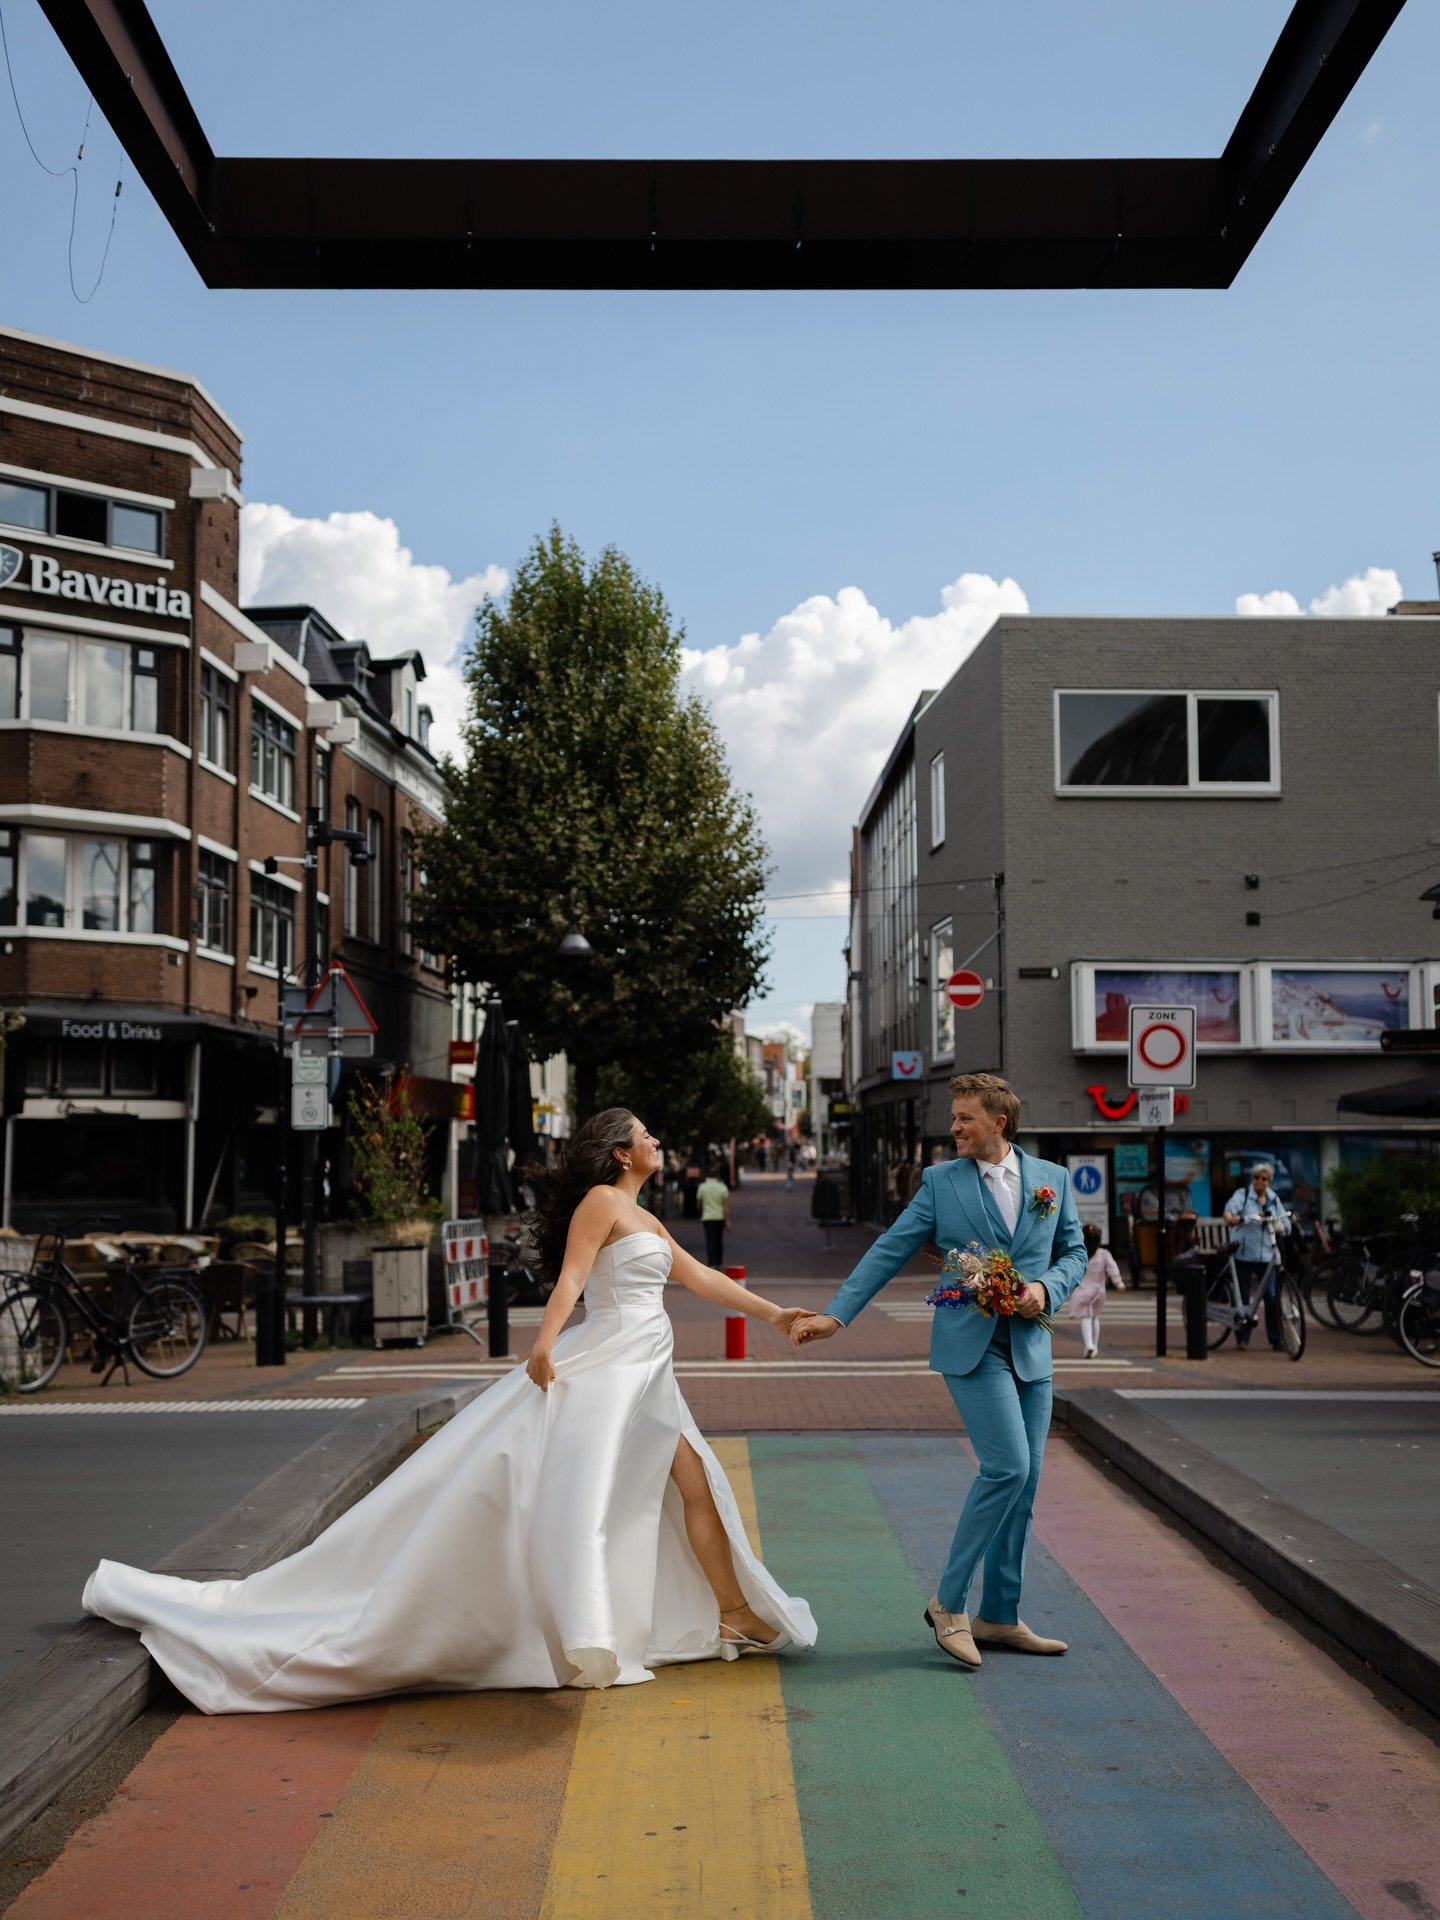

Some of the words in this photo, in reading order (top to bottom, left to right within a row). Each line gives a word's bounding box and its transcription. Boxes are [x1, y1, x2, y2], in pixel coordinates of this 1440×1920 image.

[30, 554, 192, 620] Bavaria
[1149, 1011, 1176, 1021] ZONE
[62, 1019, 104, 1039] Food
[107, 1021, 117, 1040] &
[121, 1021, 162, 1041] Drinks
